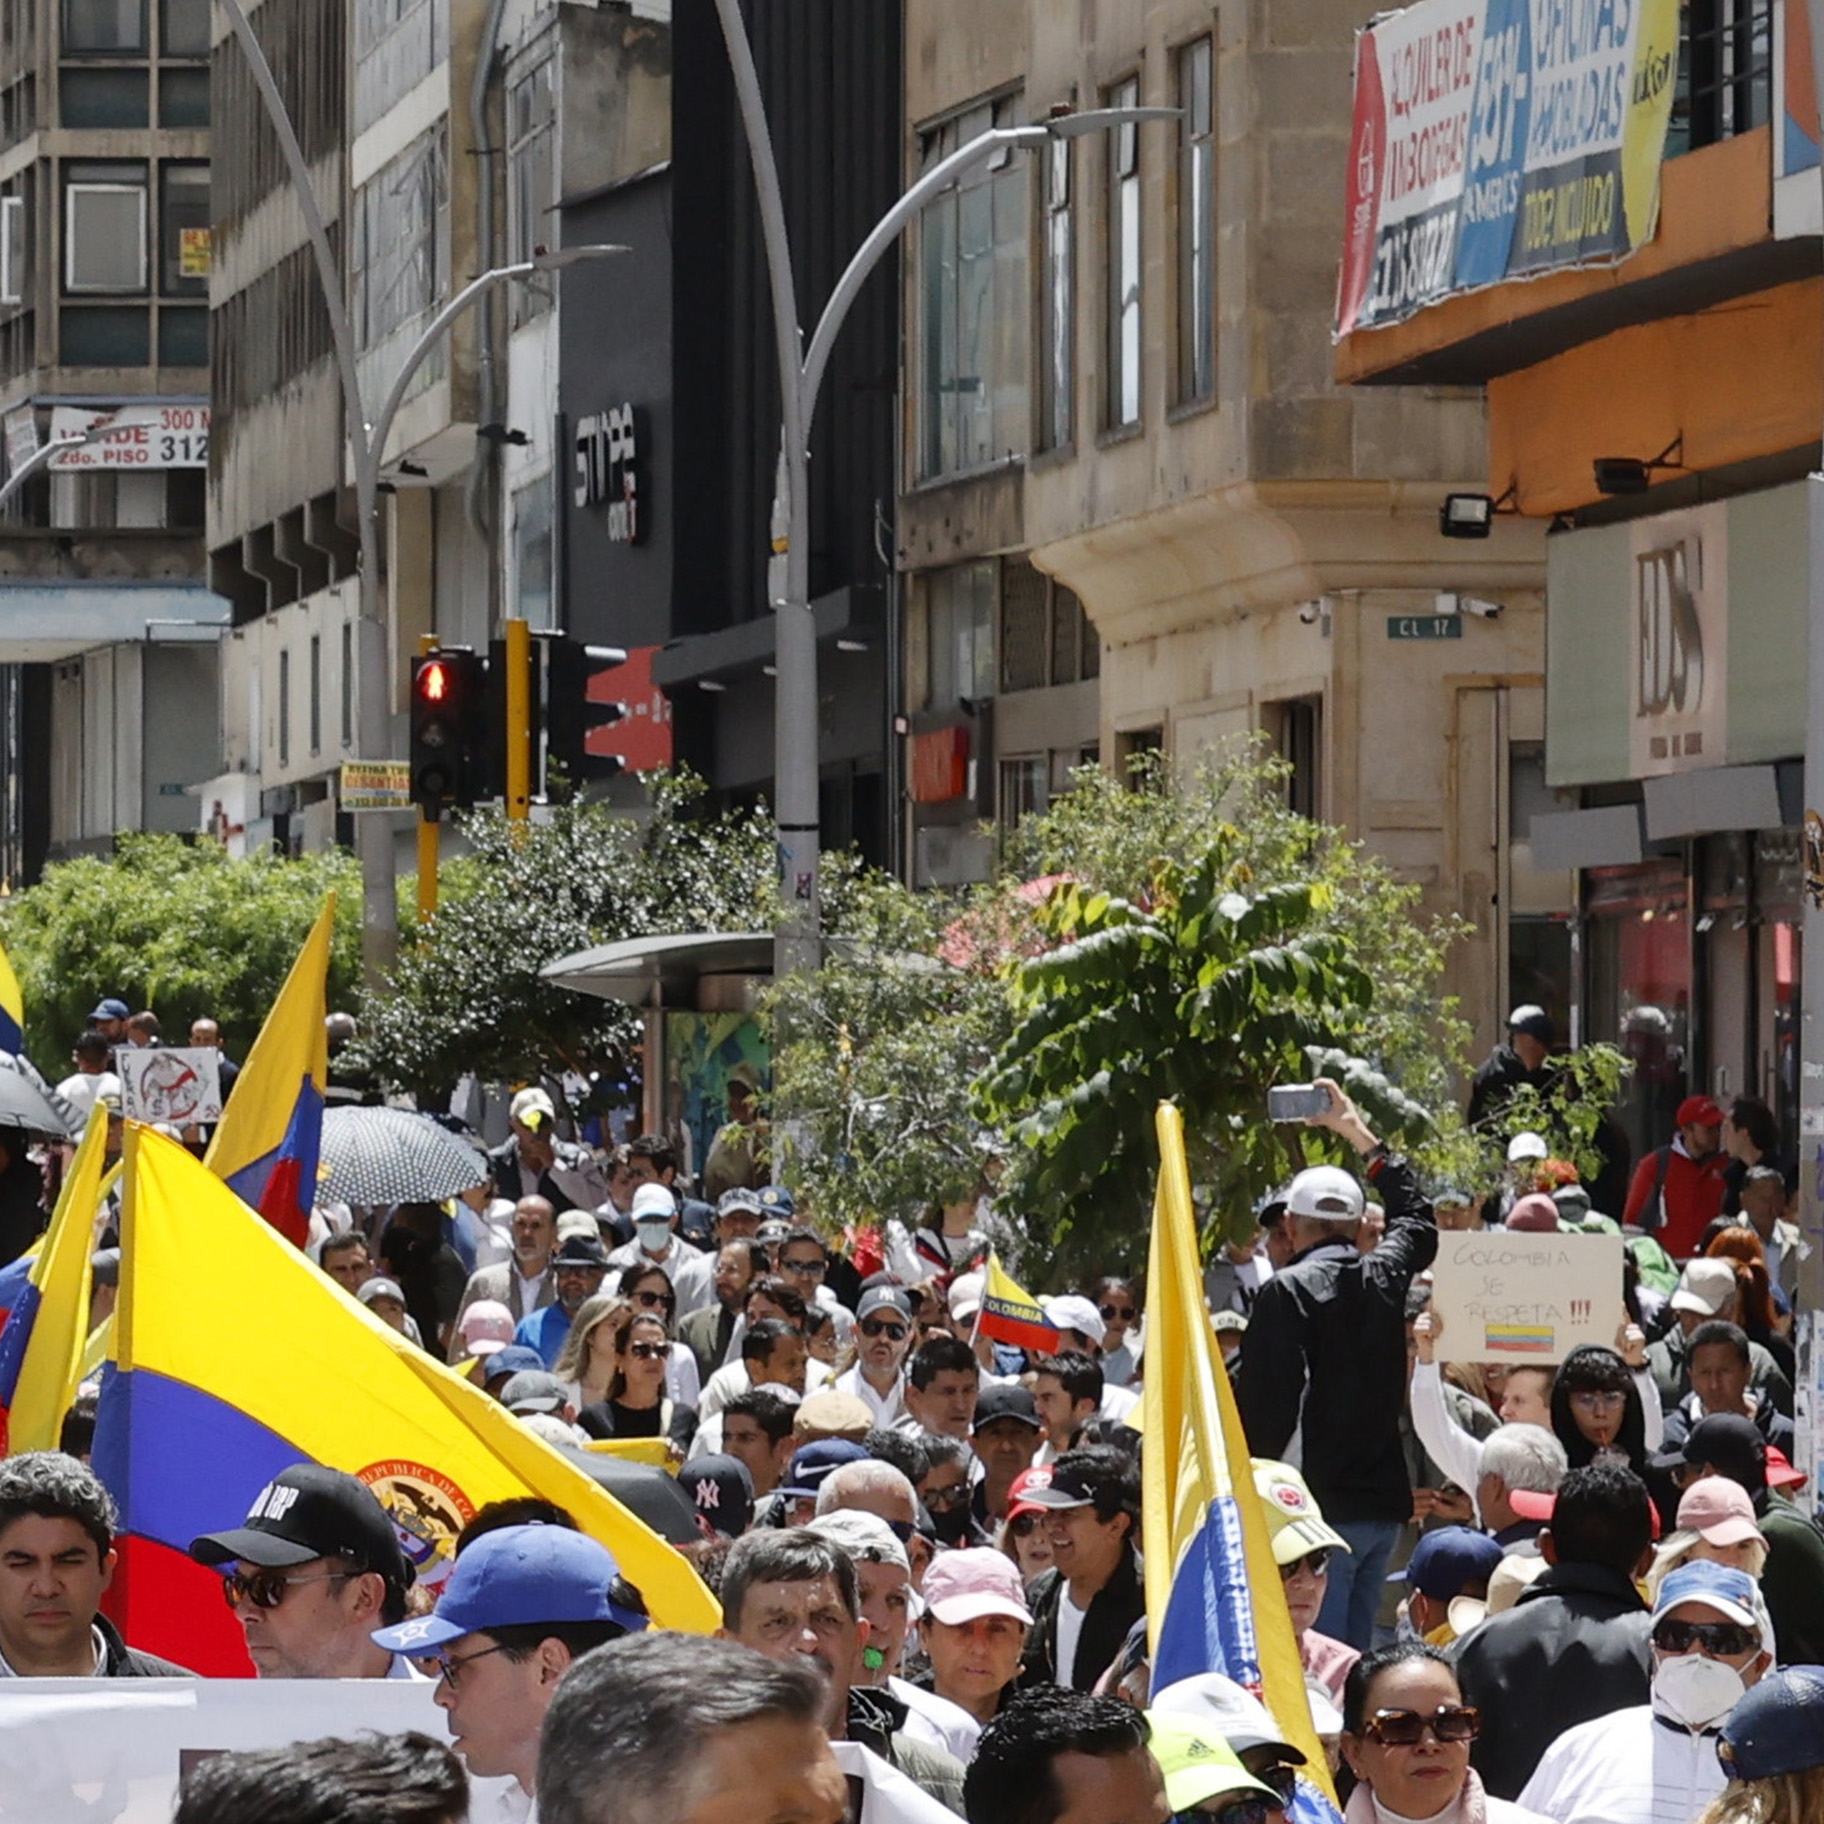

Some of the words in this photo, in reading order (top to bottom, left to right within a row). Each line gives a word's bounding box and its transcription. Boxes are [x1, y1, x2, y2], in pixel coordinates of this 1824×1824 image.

[160, 409, 194, 430] 300
[103, 449, 149, 464] PISO
[1433, 618, 1450, 636] 17
[1453, 1242, 1571, 1267] COLOMBIA
